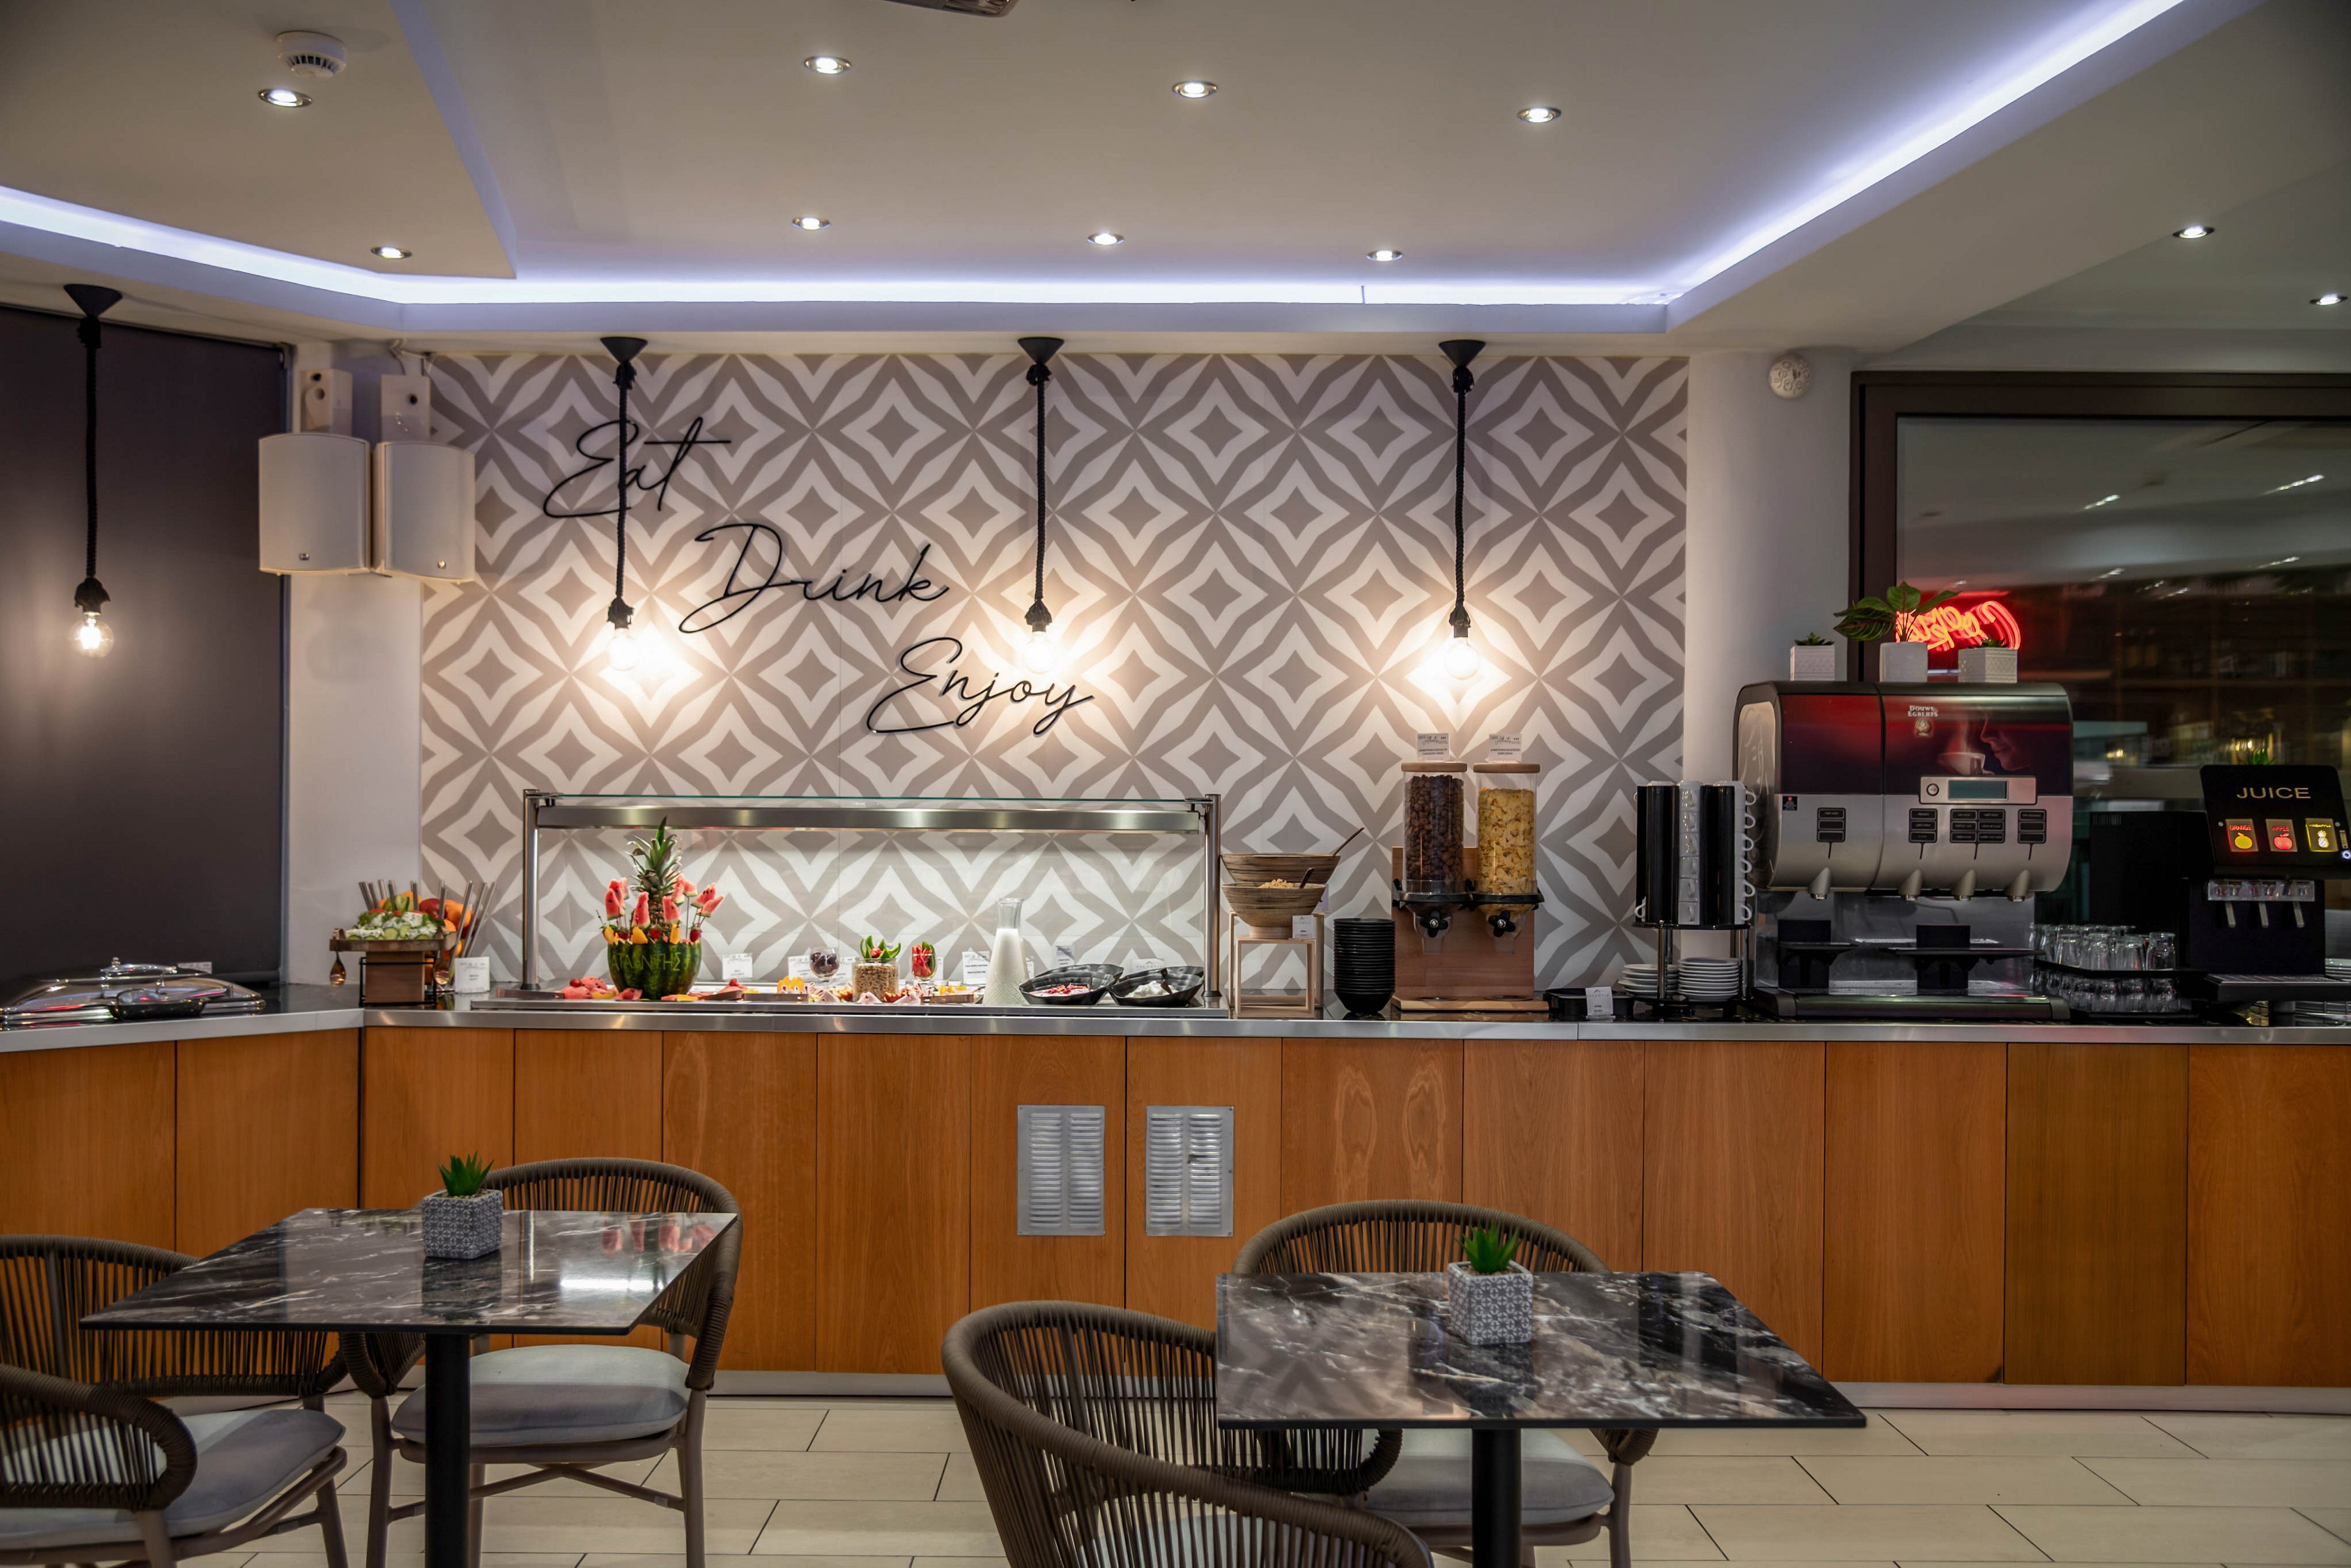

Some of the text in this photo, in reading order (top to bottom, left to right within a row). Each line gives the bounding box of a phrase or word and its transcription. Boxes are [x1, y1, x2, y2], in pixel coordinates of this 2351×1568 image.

[544, 417, 731, 518] Eat
[679, 523, 950, 633] Drink
[867, 637, 1095, 735] Enjoy
[2237, 787, 2311, 798] JUICE
